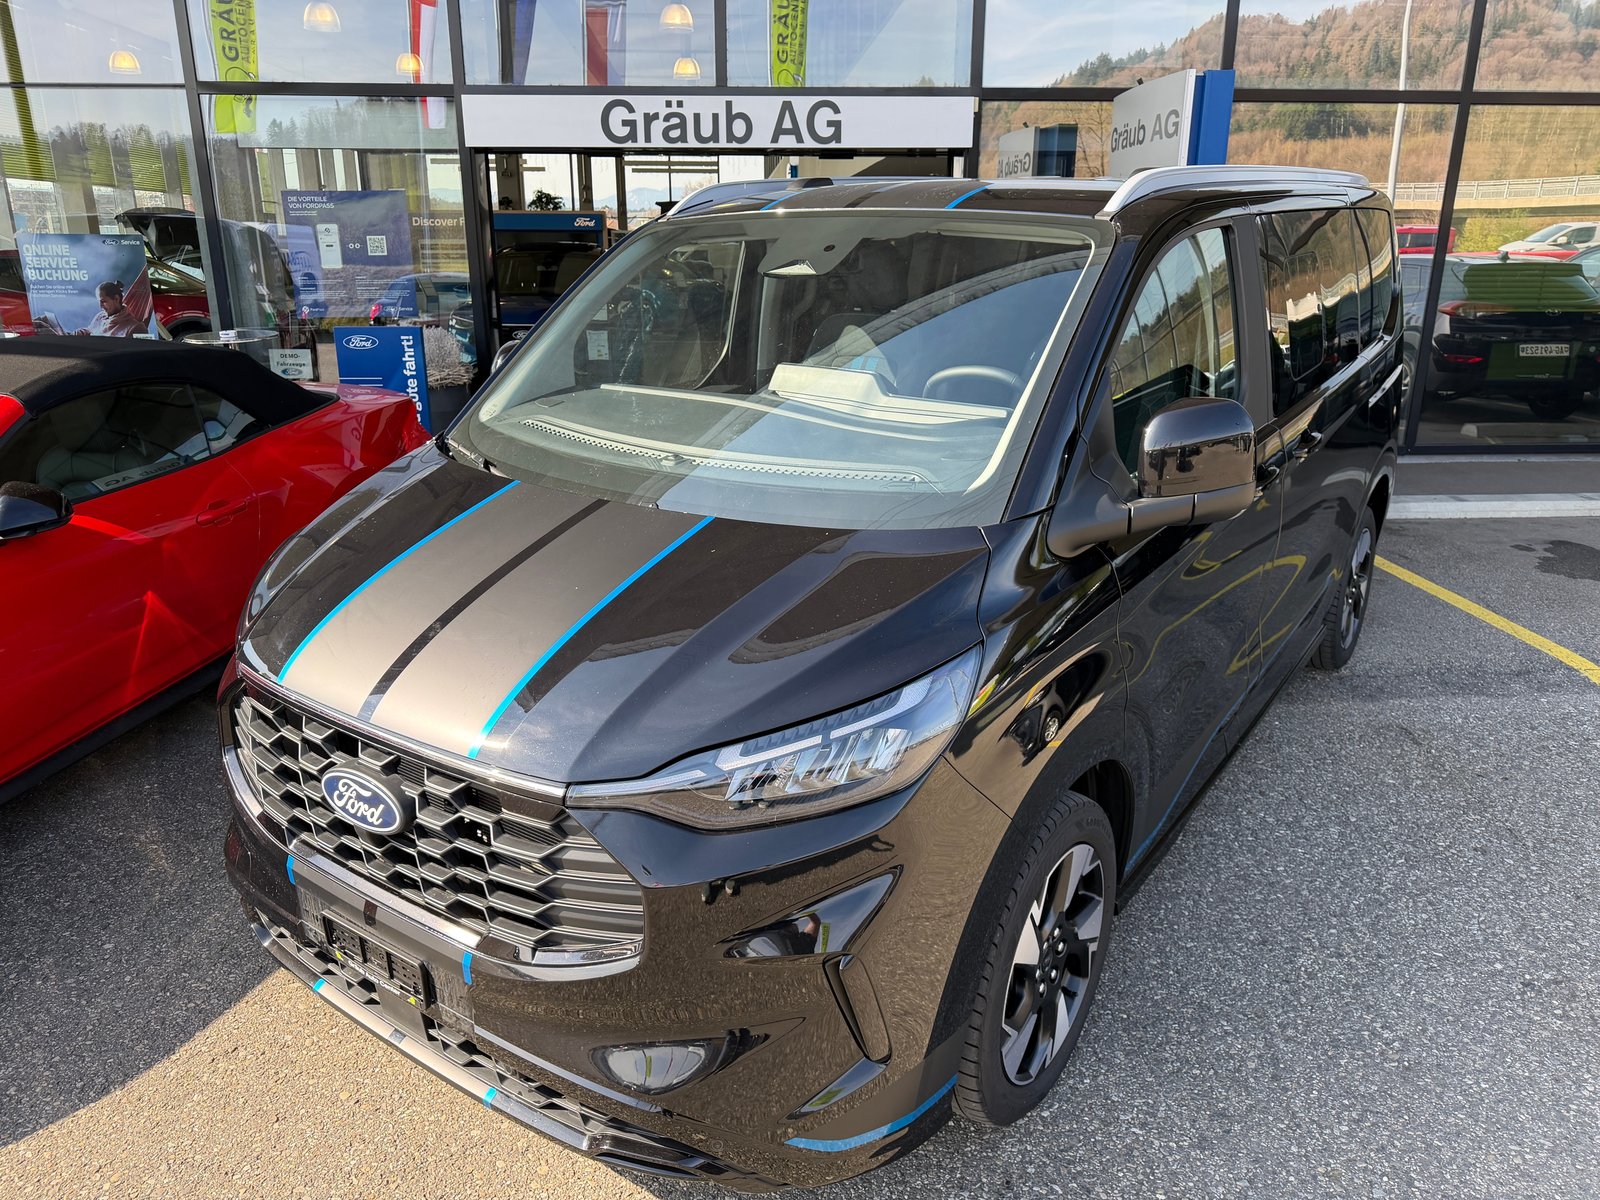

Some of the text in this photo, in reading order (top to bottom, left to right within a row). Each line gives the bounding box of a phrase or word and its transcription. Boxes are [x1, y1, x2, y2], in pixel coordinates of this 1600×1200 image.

[789, 0, 800, 66] AUTOCEN
[600, 98, 843, 145] Gräub AG
[1110, 108, 1181, 154] Gräub AG
[412, 216, 458, 227] Discover
[574, 217, 596, 227] Ford
[23, 244, 71, 256] ONLINE
[26, 257, 78, 269] SERVICE
[28, 269, 89, 281] BUCHUNG
[349, 336, 373, 348] Ford
[400, 335, 417, 377] fahrt!
[276, 361, 307, 369] Fahrzeuge
[333, 778, 385, 826] Ford
